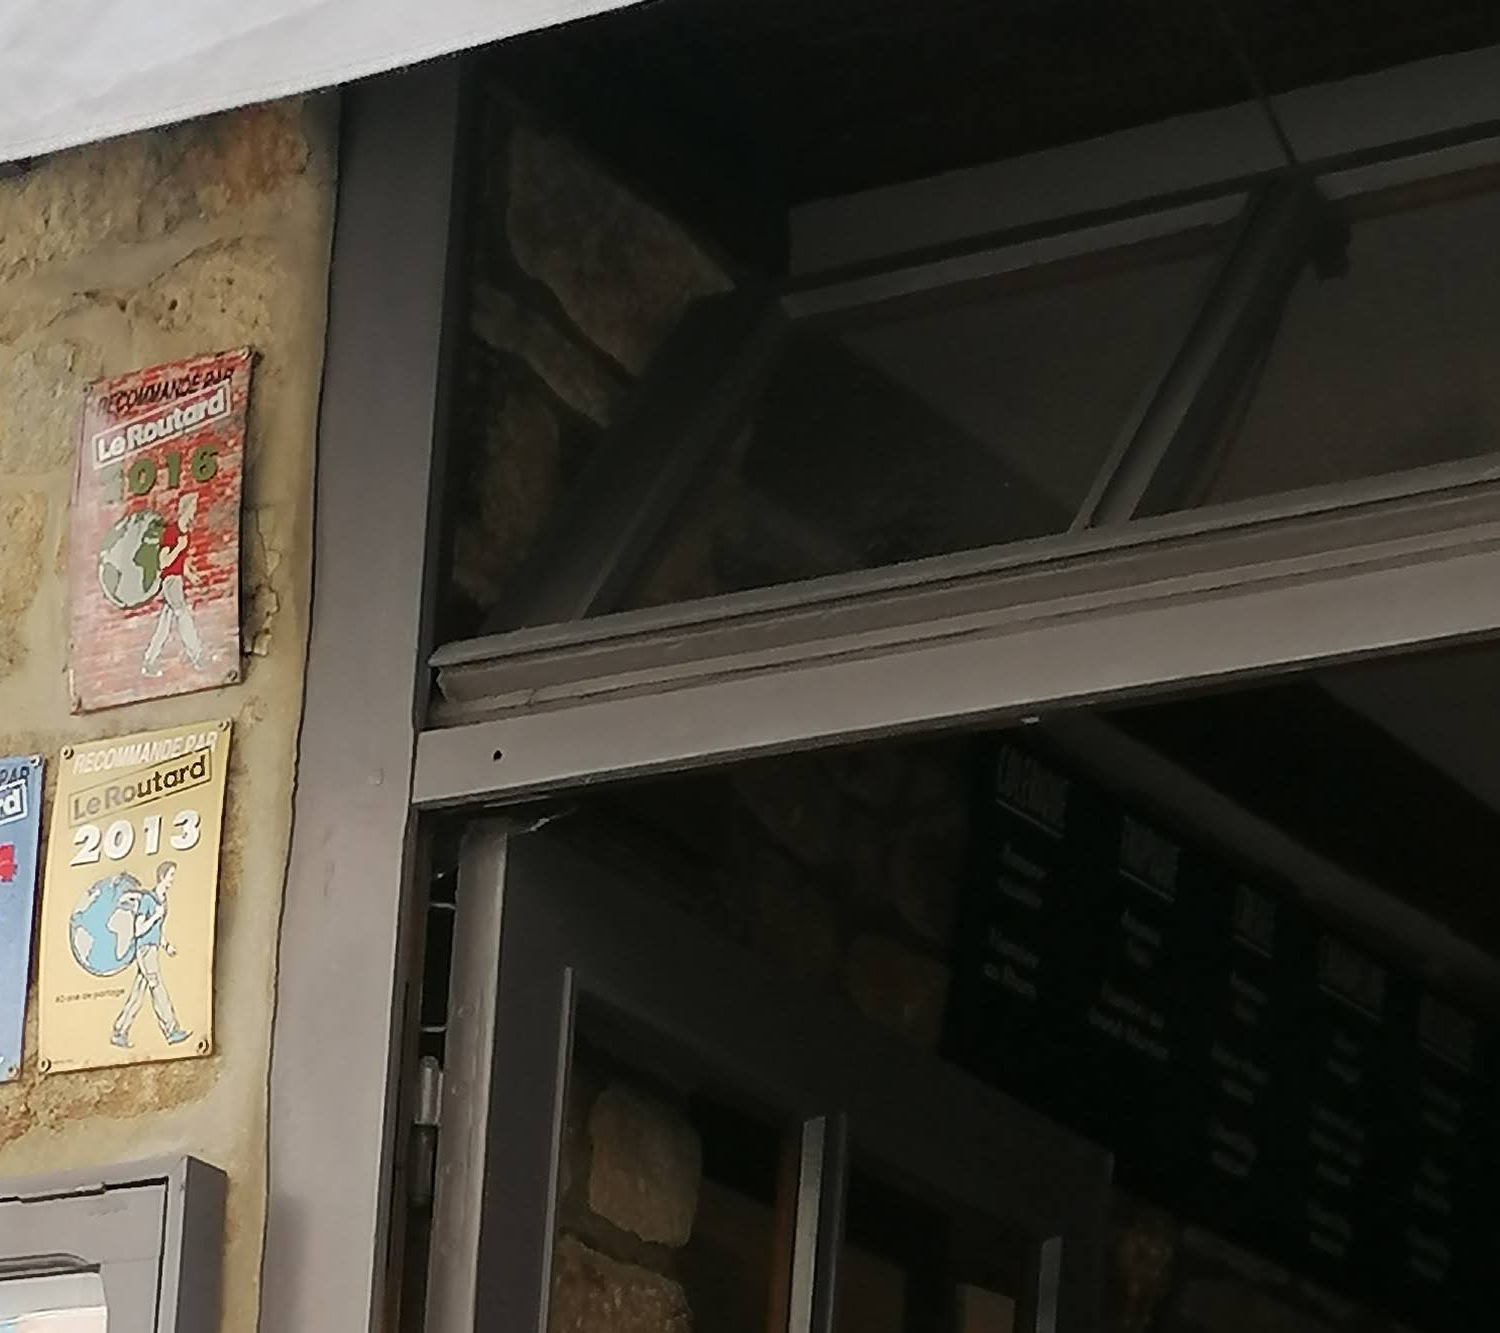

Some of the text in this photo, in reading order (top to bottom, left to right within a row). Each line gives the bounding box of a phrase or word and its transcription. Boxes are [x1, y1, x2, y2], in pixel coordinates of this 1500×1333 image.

[98, 387, 227, 463] Le Routard
[104, 445, 219, 503] 016
[74, 754, 206, 821] Le Routard
[70, 809, 201, 867] 2013
